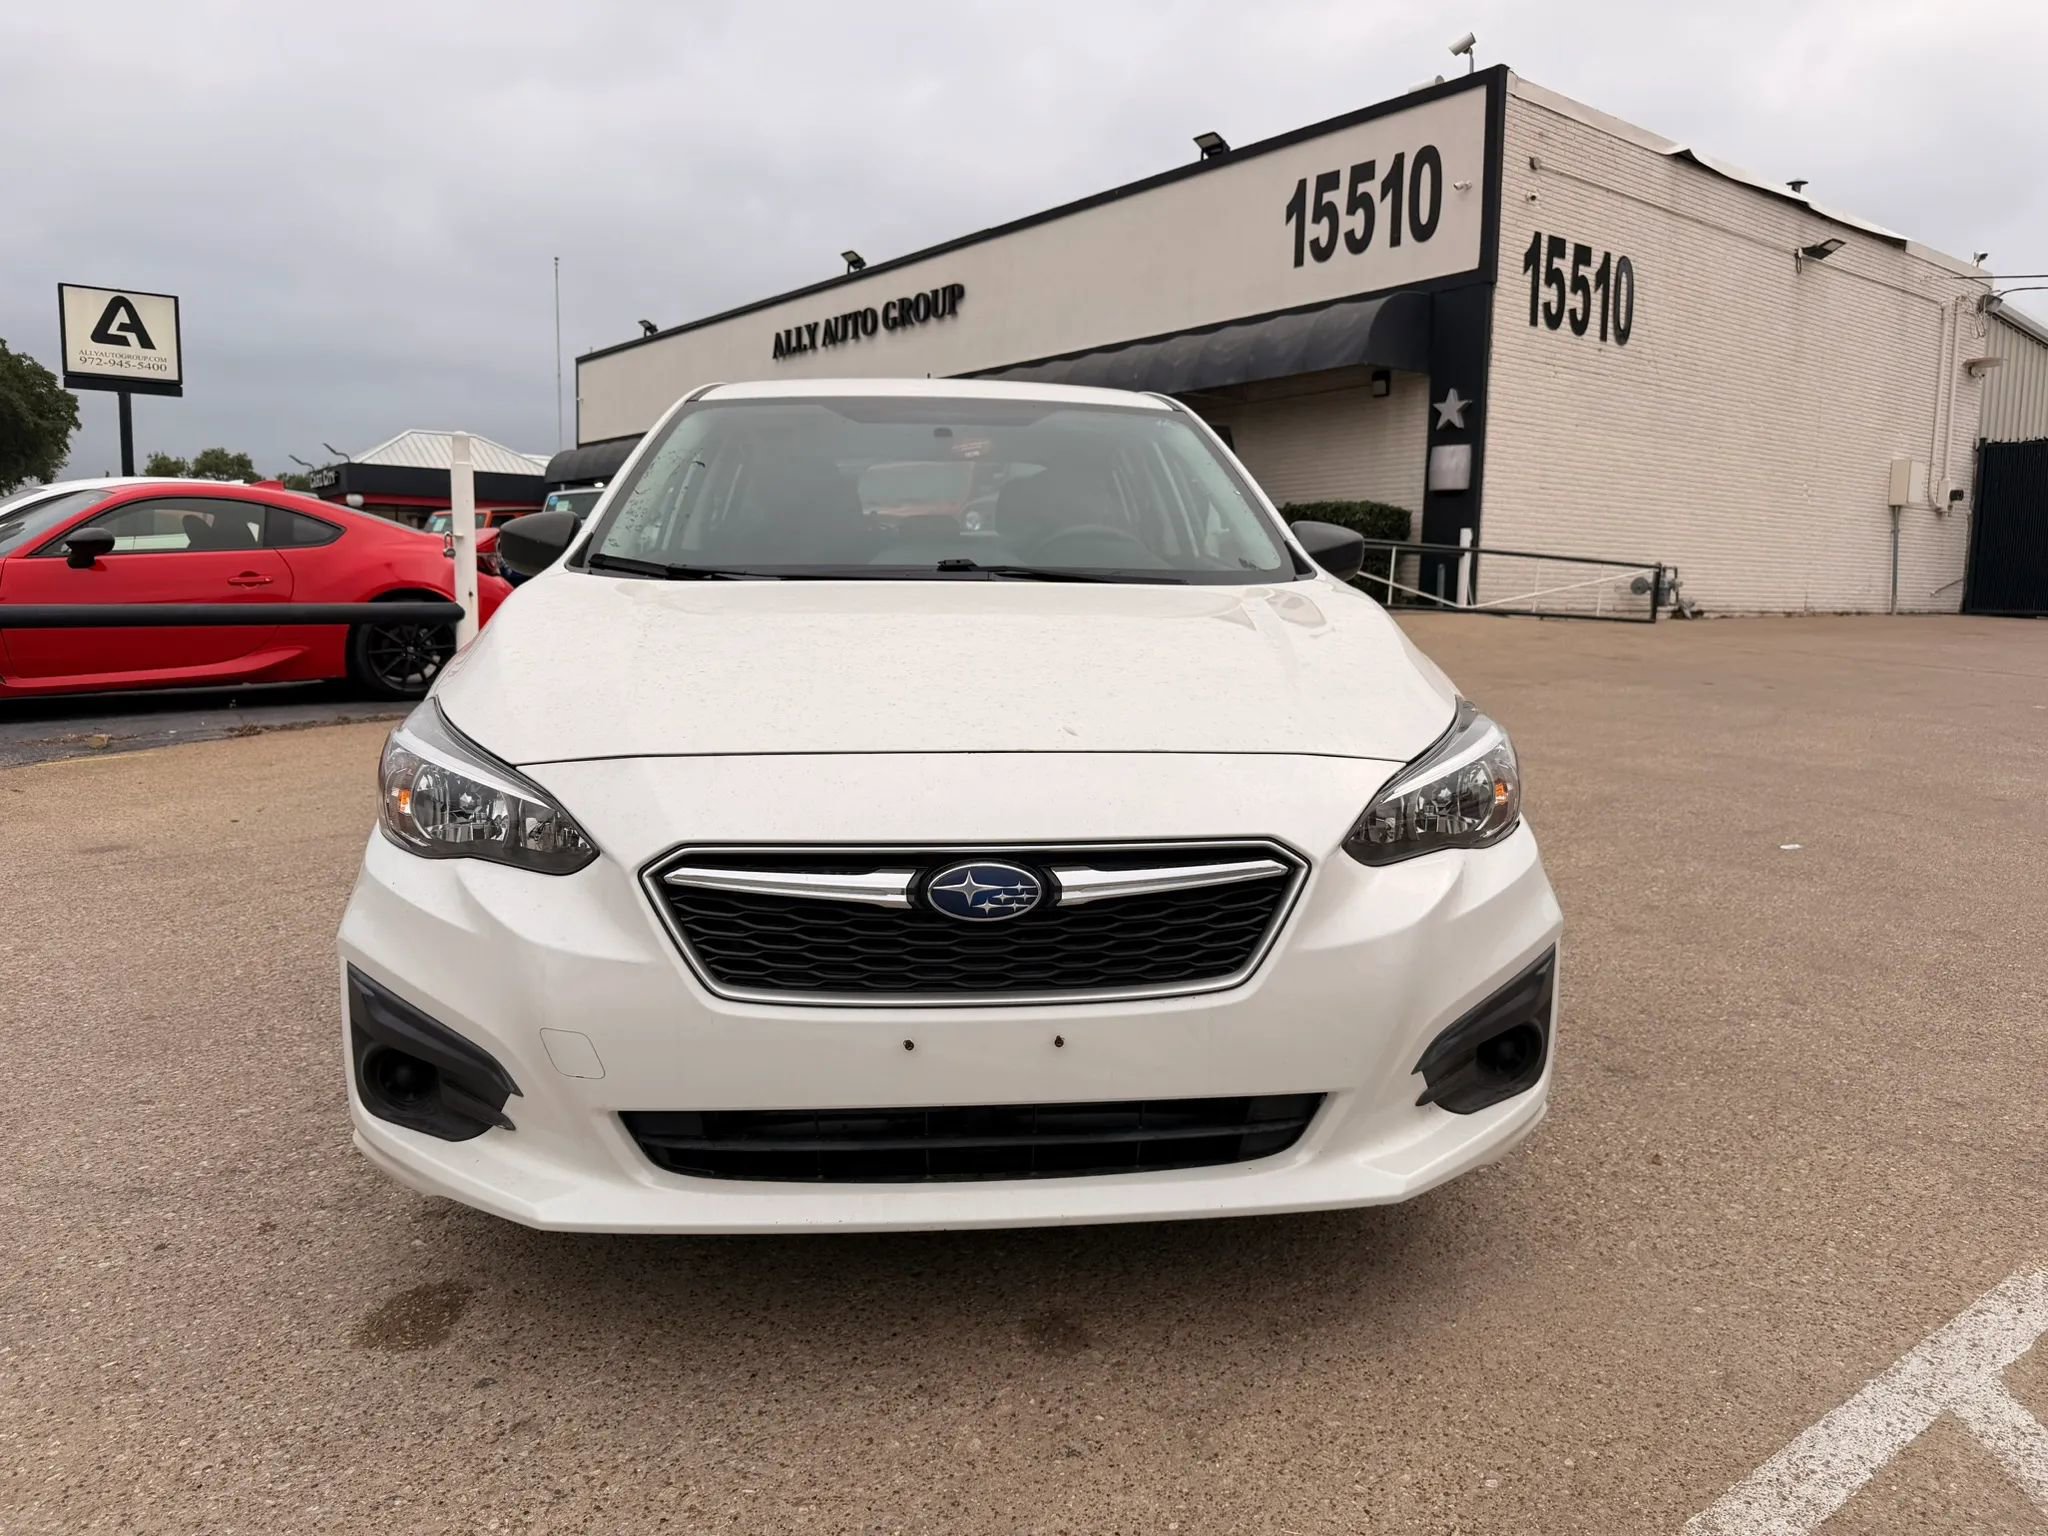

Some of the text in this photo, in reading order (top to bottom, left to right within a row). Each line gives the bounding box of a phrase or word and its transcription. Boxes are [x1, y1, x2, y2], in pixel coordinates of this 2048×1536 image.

[1285, 144, 1442, 268] 15510
[772, 283, 965, 360] ALLY AUTO GROUP
[1523, 231, 1634, 346] 15510
[79, 356, 167, 371] 972-945-5400
